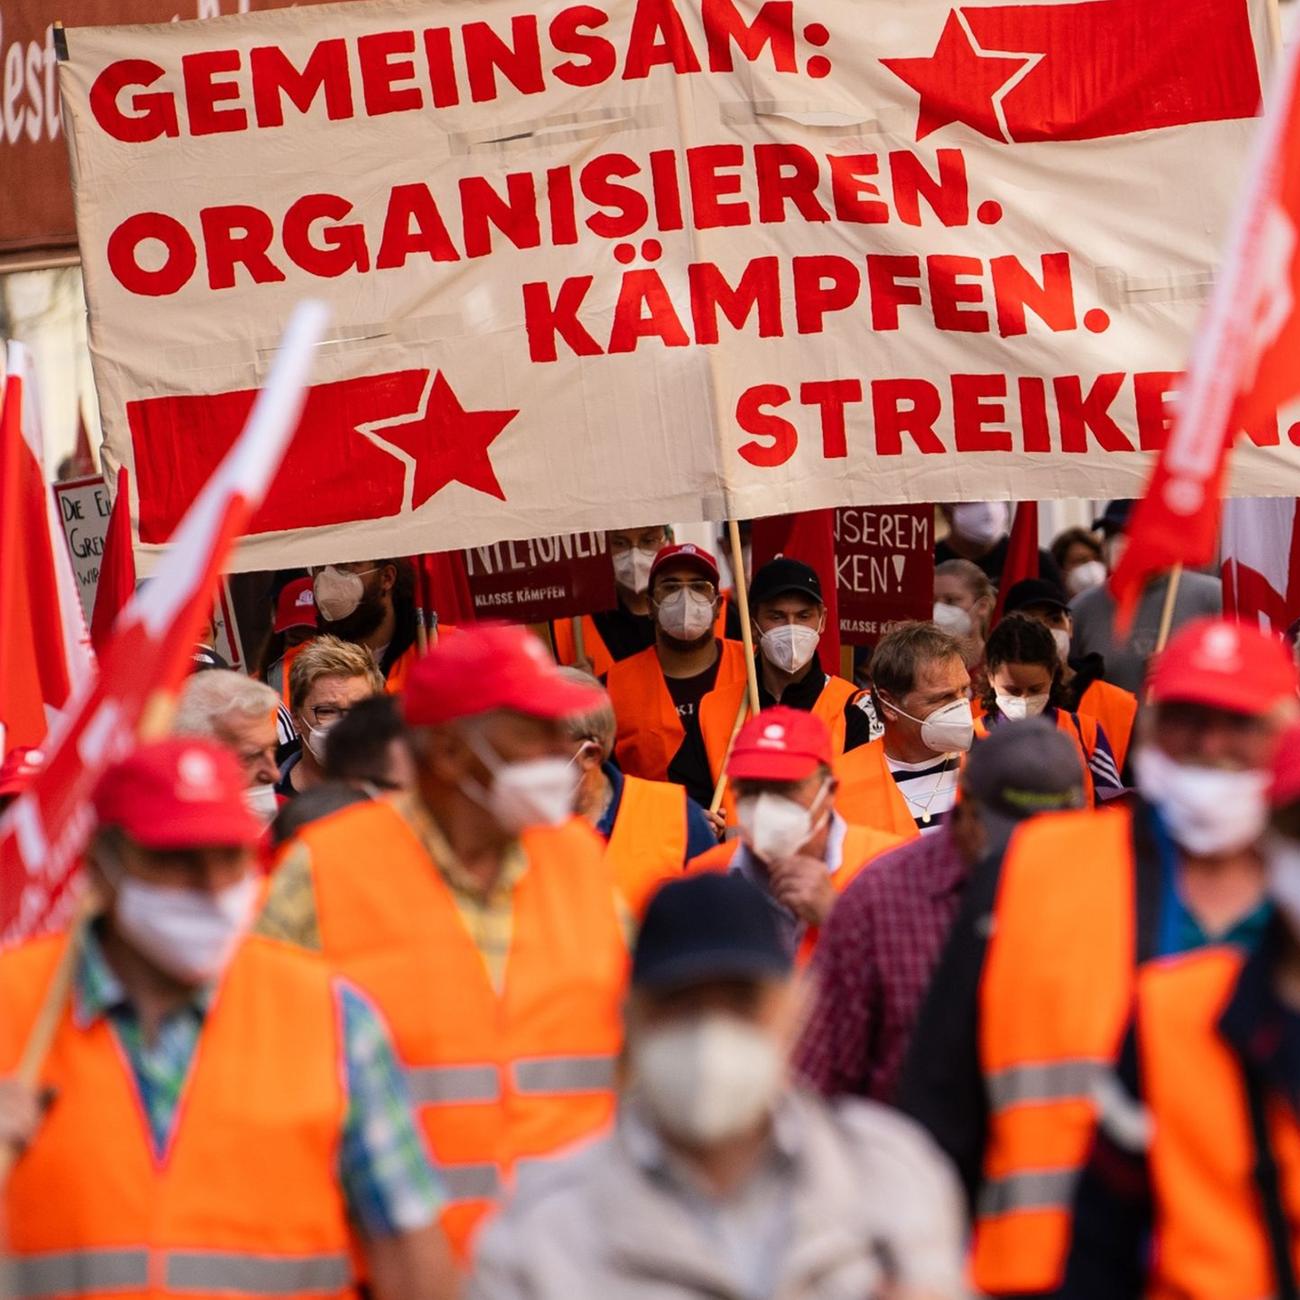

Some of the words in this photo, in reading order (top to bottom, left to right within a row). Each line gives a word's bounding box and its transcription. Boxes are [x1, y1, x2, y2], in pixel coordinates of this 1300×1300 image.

[0, 18, 60, 145] est
[89, 0, 831, 143] GEMEINSAM:
[106, 144, 1003, 297] ORGANISIEREN.
[522, 238, 1110, 362] KÄMPFEN.
[61, 495, 85, 522] DIE
[474, 591, 514, 608] KLASSE
[516, 585, 566, 603] KÄMPFEN
[840, 619, 878, 632] KLASSE
